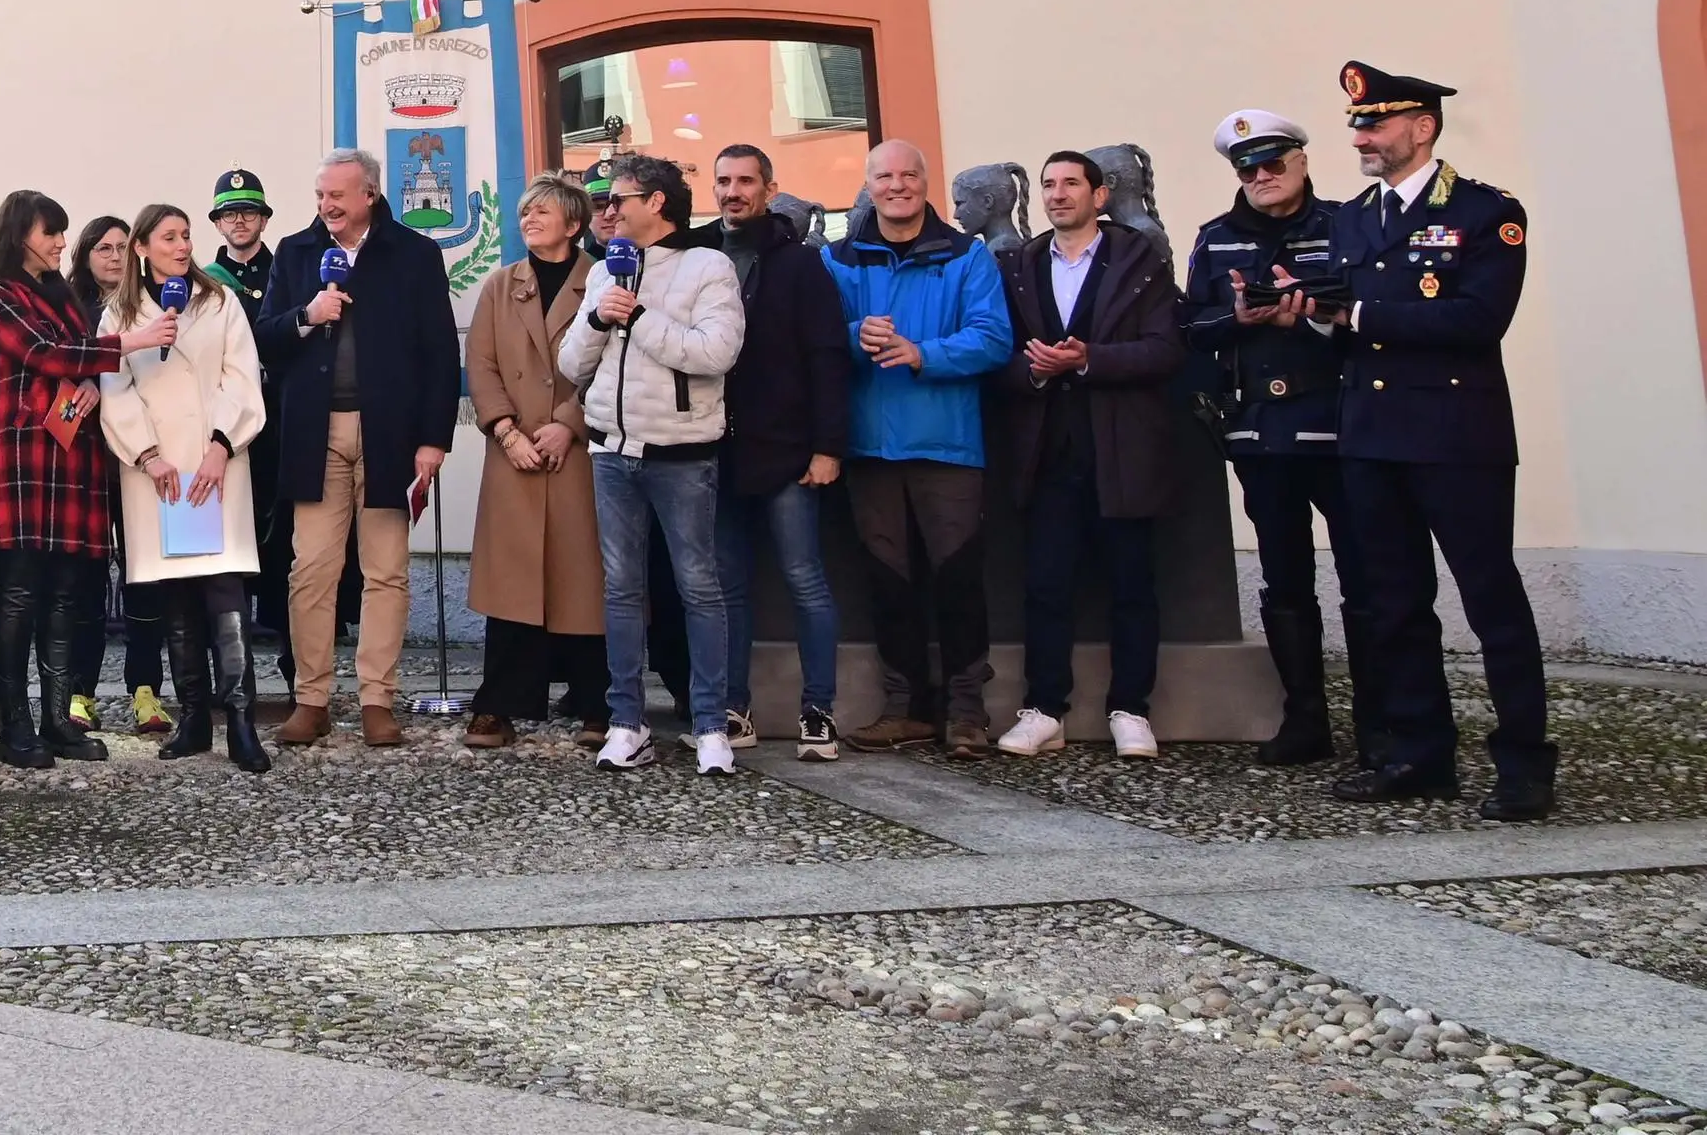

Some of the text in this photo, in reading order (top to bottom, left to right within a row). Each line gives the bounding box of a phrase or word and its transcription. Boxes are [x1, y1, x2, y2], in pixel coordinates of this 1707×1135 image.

[360, 38, 489, 66] COMUNE DI SAREZZO
